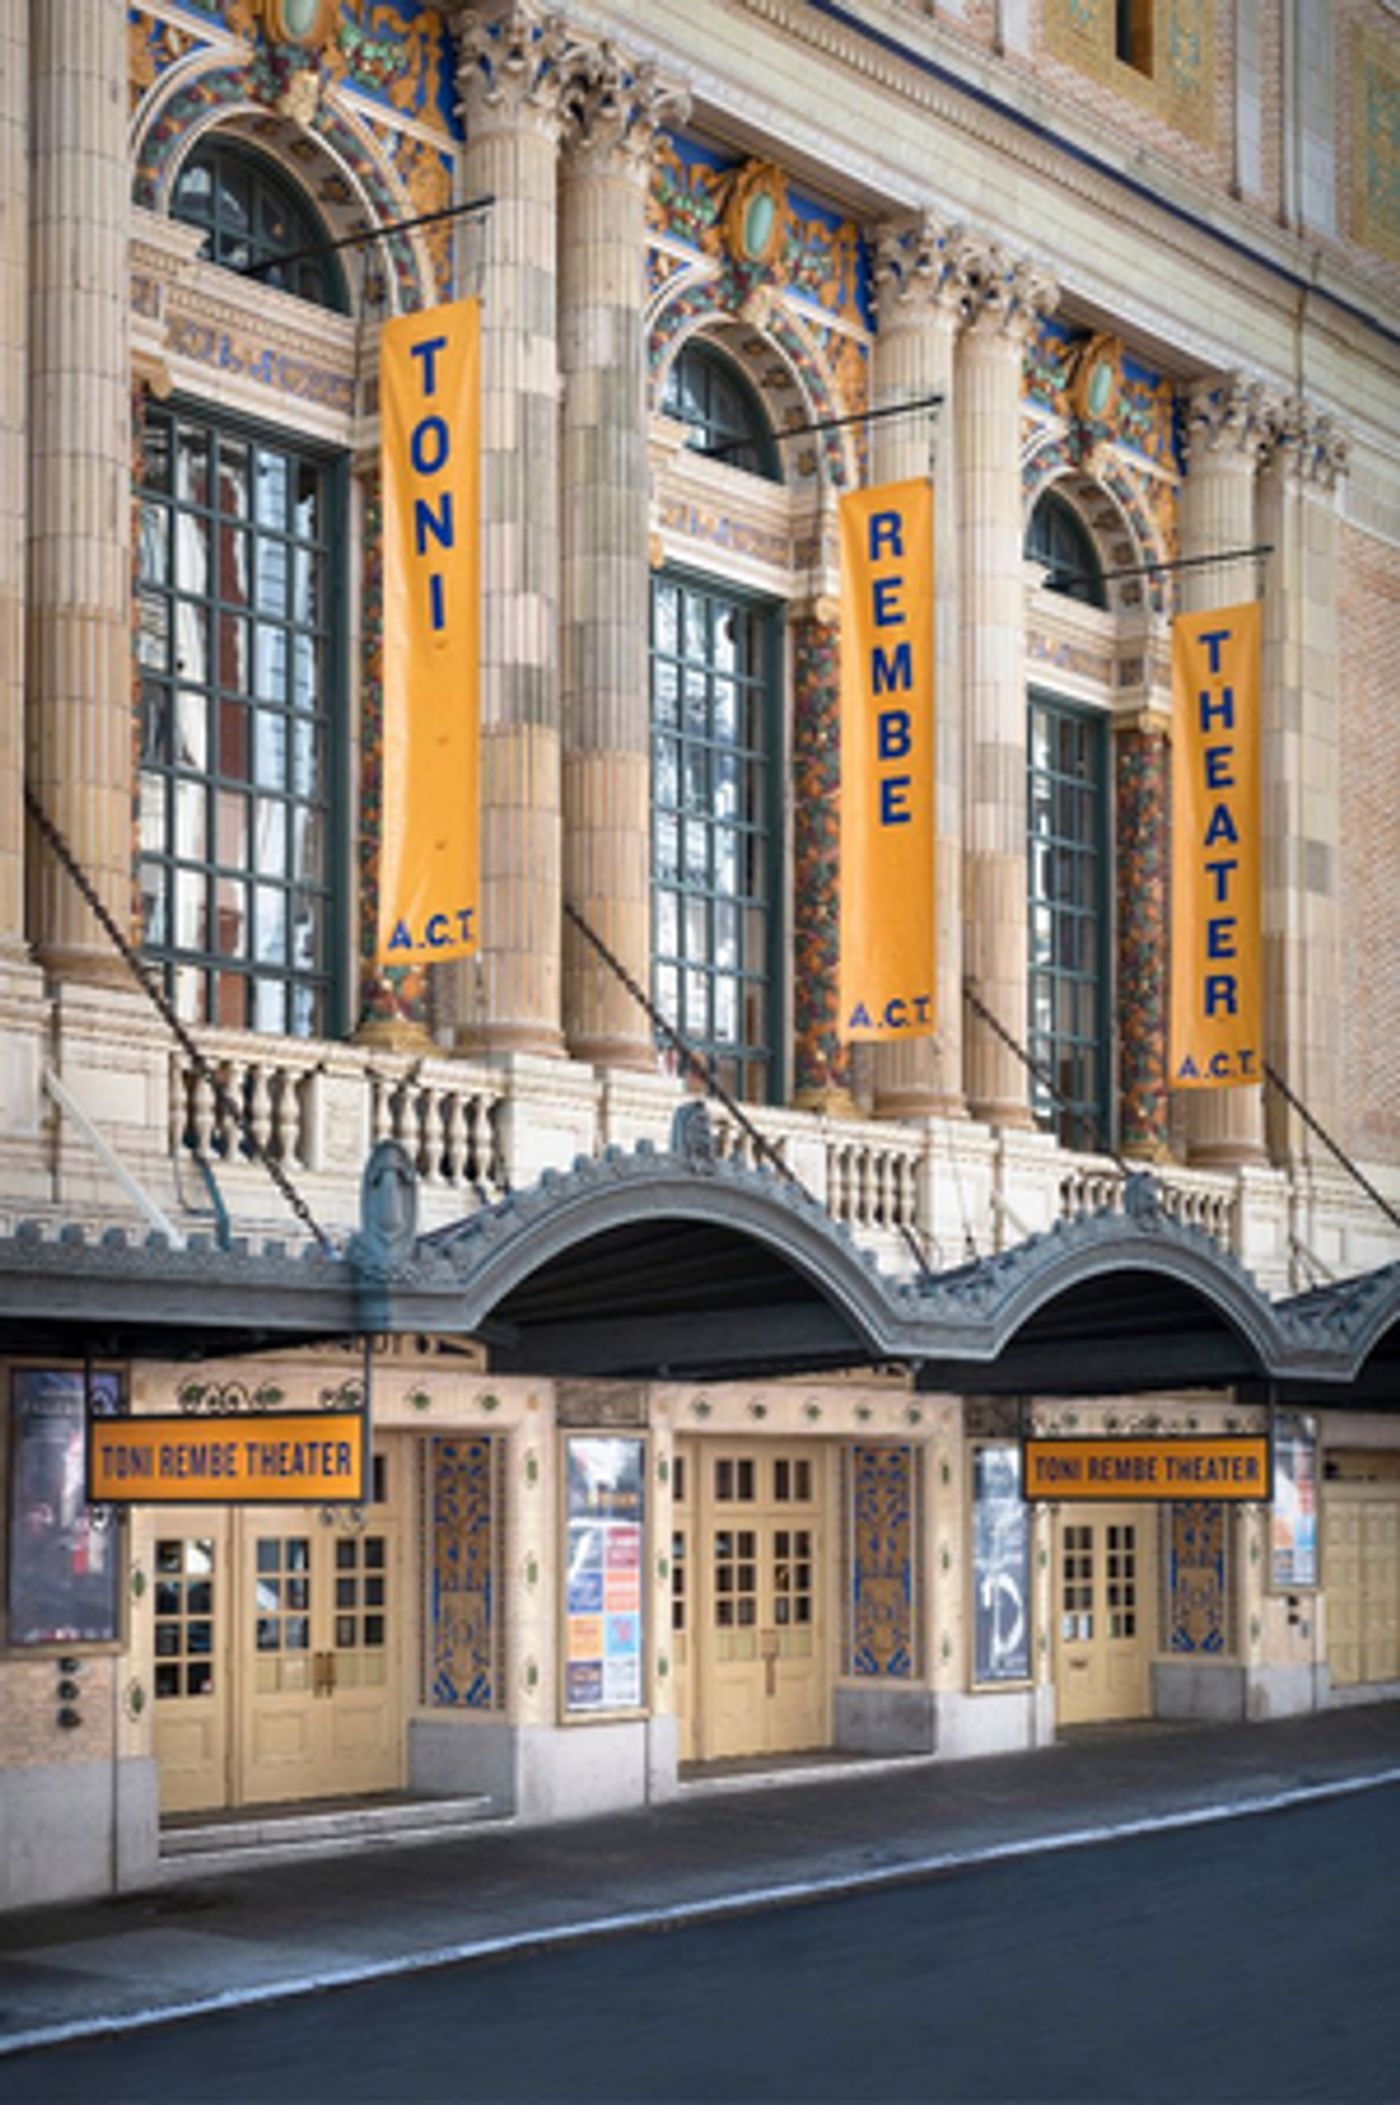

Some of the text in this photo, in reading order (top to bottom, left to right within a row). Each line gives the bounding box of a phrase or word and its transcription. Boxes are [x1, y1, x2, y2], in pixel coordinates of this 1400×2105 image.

[410, 336, 453, 630] TONI
[868, 510, 913, 826] REMBE
[1198, 630, 1238, 1016] THEATER
[101, 1440, 352, 1480] TONI REMBE THEATER
[1035, 1455, 1259, 1482] TONI REMBE THEATER
